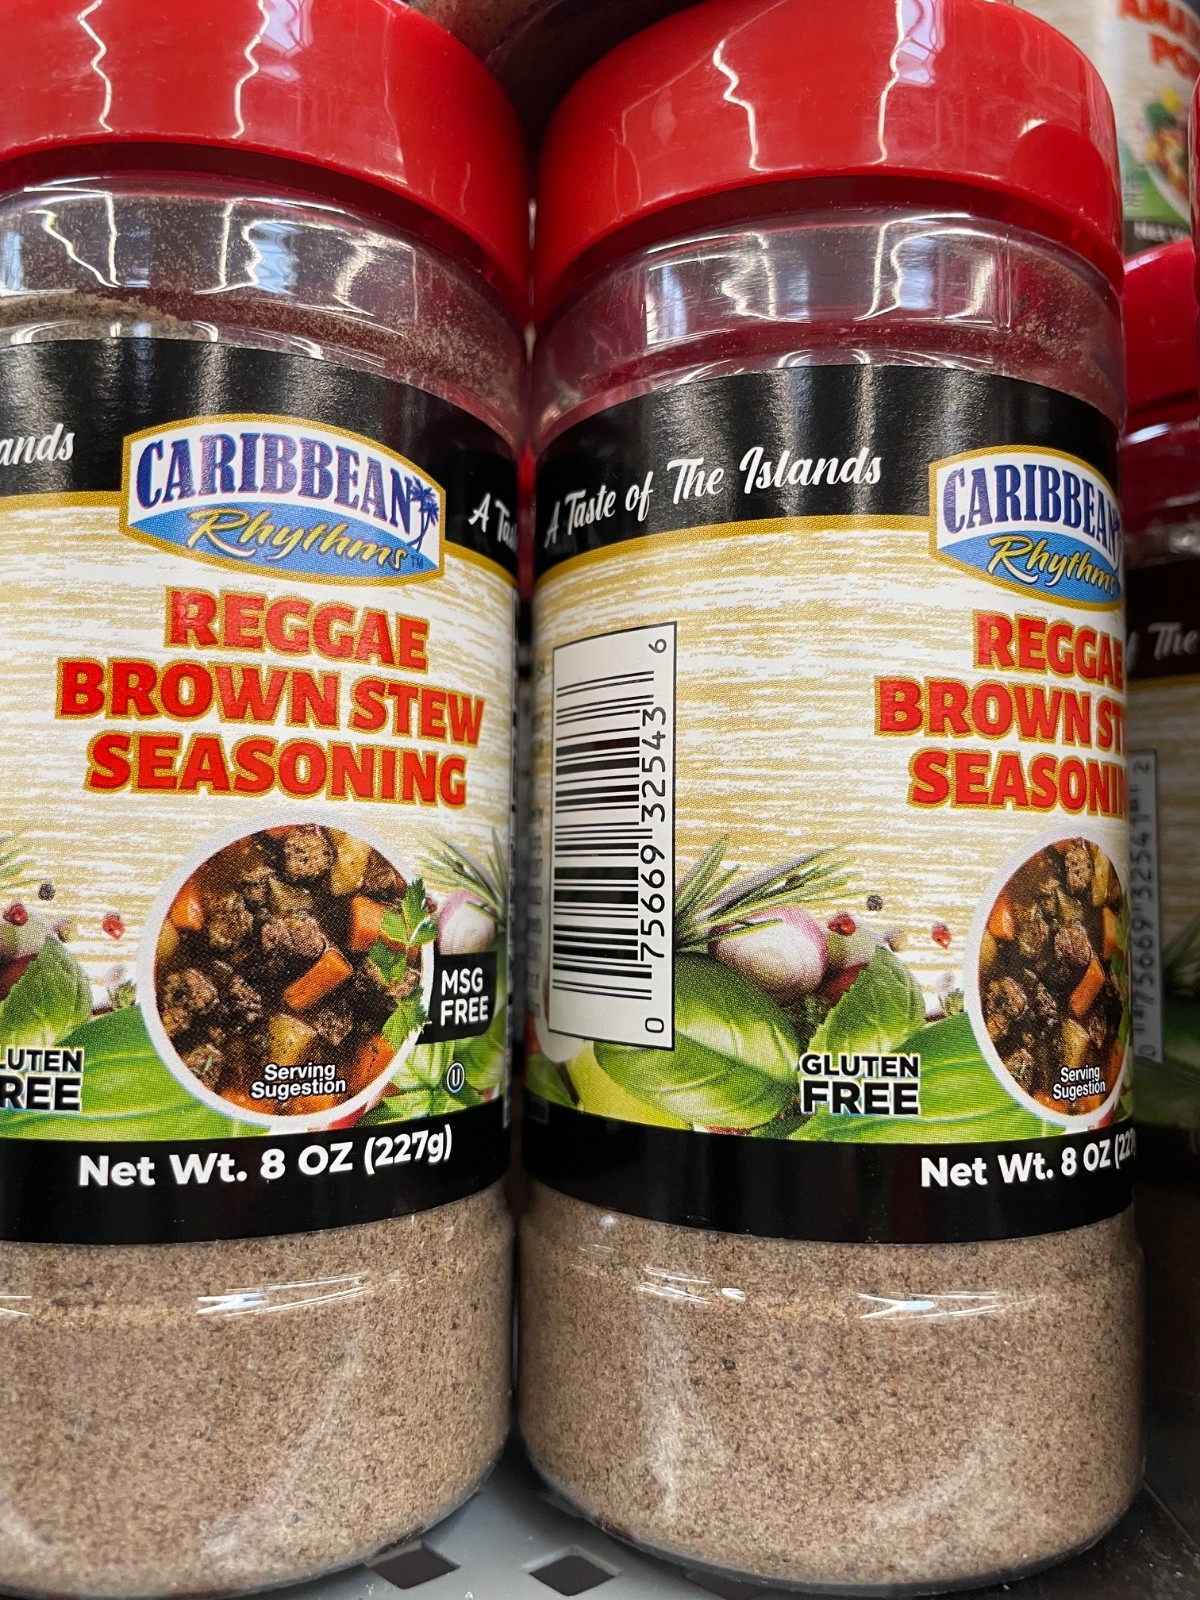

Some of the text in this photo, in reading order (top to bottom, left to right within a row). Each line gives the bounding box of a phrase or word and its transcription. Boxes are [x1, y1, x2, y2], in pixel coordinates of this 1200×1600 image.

[135, 432, 416, 535] CARIBBEAN
[545, 446, 882, 548] A Taste of The Islands
[187, 507, 408, 572] Rhythms
[468, 492, 490, 533] A
[167, 589, 429, 672] REGGAE
[973, 610, 1125, 693] REGGAE
[57, 658, 485, 747] BROWN STEW
[875, 676, 1092, 748] BROWN
[85, 731, 467, 809] SEASONING
[641, 638, 667, 1034] 0 75669 32543 6
[440, 967, 484, 994] MSG
[440, 996, 489, 1026] FREE
[251, 1078, 347, 1101] Sugestion
[264, 1063, 336, 1082] Serving
[801, 1053, 920, 1077] GLUTEN
[1052, 1079, 1106, 1101] Sugestion
[1060, 1065, 1101, 1083] Serving
[802, 1081, 920, 1115] FREE
[79, 1125, 452, 1187] Net Wt. 8 OZ (227g)
[921, 1156, 988, 1187] Net
[998, 1152, 1054, 1184] Wt.
[1061, 1147, 1077, 1176] 8
[1083, 1139, 1111, 1171] OZ
